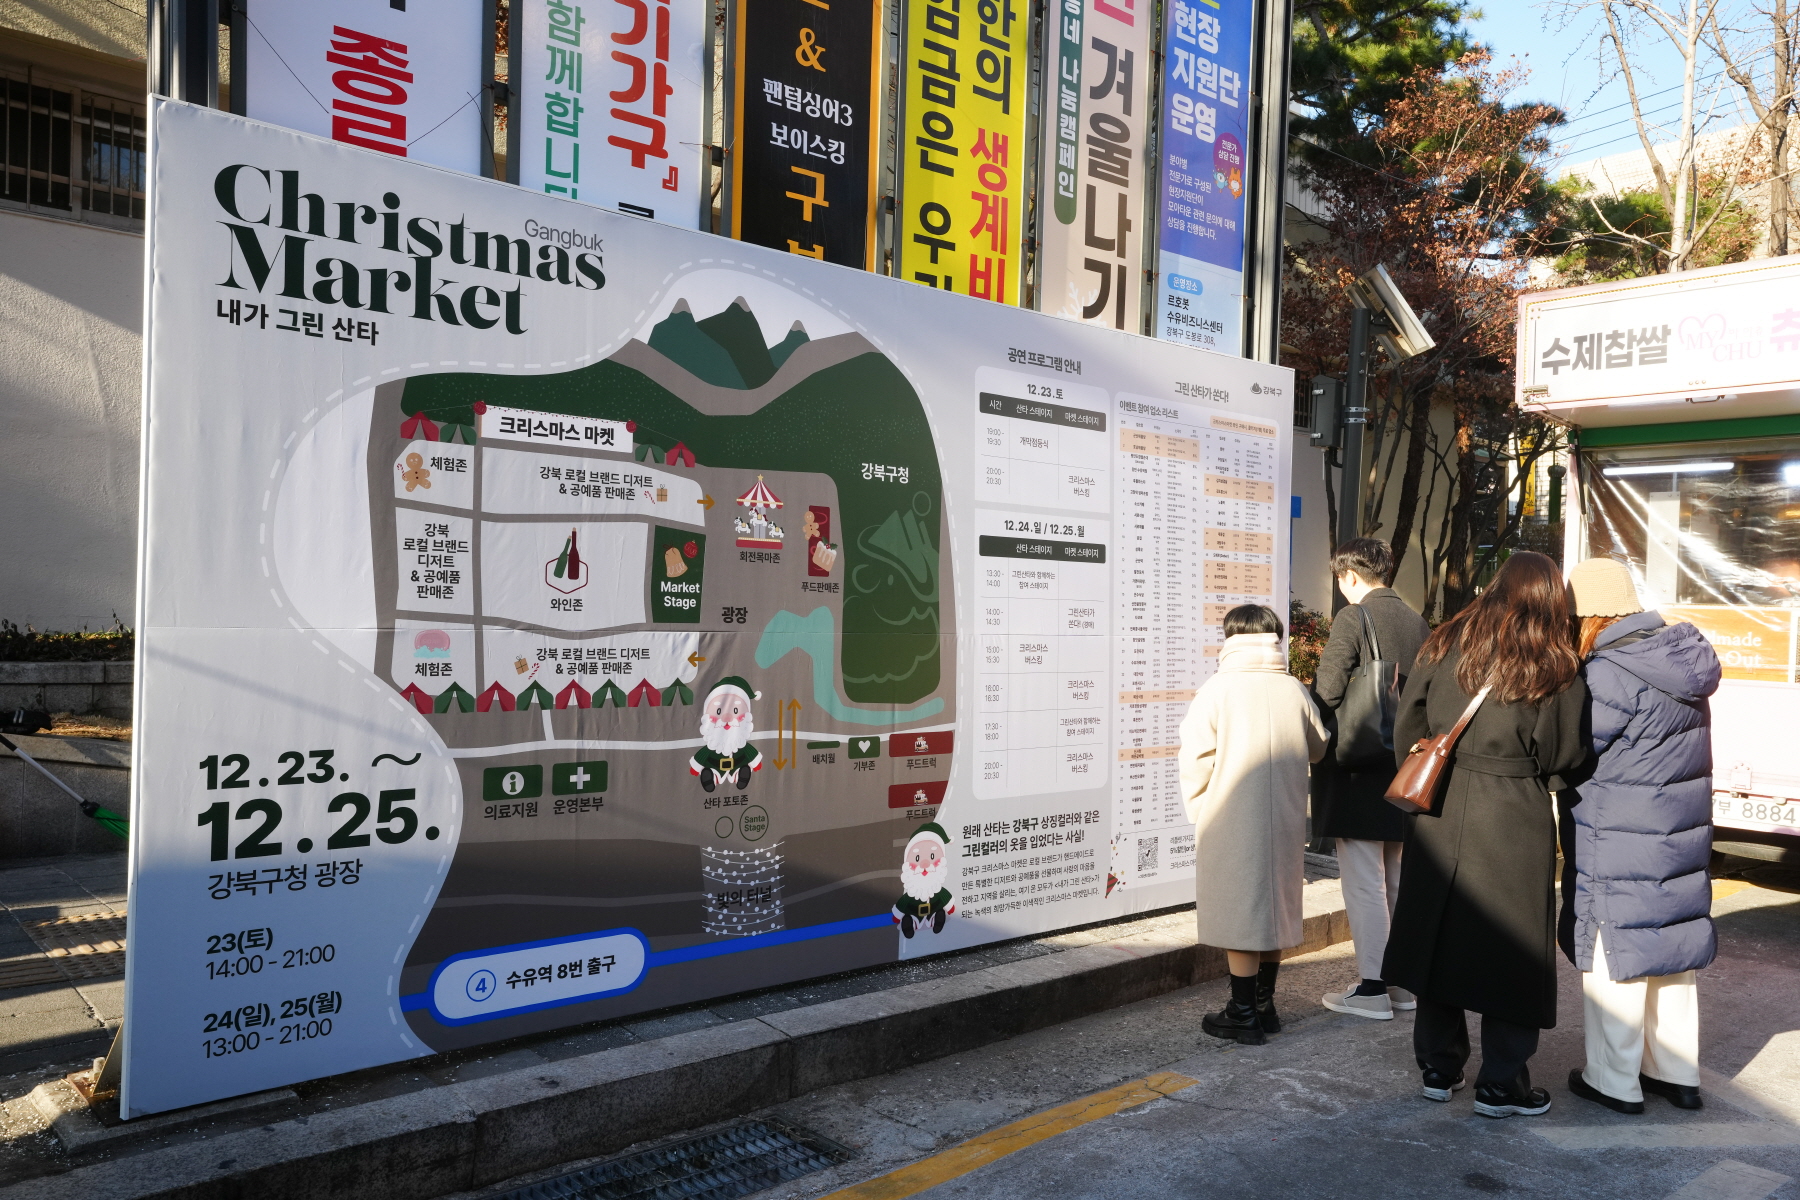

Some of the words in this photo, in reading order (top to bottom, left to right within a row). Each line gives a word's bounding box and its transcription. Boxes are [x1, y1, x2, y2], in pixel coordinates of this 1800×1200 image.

[1174, 0, 1221, 54] 현장
[795, 28, 826, 72] &
[1172, 47, 1241, 108] 지원단
[545, 0, 585, 199] 함께합니
[763, 78, 853, 127] 팬텀싱어3
[1171, 93, 1216, 143] 운영
[770, 122, 845, 165] 보이스킹
[1169, 154, 1188, 170] 분야별
[1083, 36, 1134, 330] 겨울나기
[1168, 170, 1193, 187] 전문가로
[1194, 179, 1212, 194] 구성된
[1168, 185, 1204, 206] 현장지원단이
[970, 128, 1009, 303] 생계비
[1167, 201, 1192, 218] 모아타운
[1224, 219, 1236, 231] 대해
[214, 164, 606, 290] Christmas
[523, 218, 604, 252] Gangbuk
[1167, 216, 1186, 232] 상담을
[1187, 222, 1217, 240] 진행합니다.
[215, 221, 527, 335] Market
[1173, 276, 1198, 292] 운영장소
[1167, 294, 1190, 311] 르호봇
[217, 300, 268, 330] 내가
[275, 308, 324, 338] 그린
[331, 316, 379, 346] 산타
[1166, 310, 1223, 334] 수유비즈니스센터
[1166, 327, 1184, 339] 강북구
[1185, 331, 1202, 342] 도봉로
[1541, 324, 1671, 376] 수제찹쌀
[1008, 347, 1026, 365] 공연
[1027, 352, 1063, 372] 프로그램
[1064, 359, 1082, 375] 안내
[1175, 382, 1190, 397] 그린
[1190, 384, 1212, 400] 산타가
[1213, 388, 1229, 403] 쏜다!
[1263, 386, 1283, 398] 강북구
[989, 399, 1002, 411] 시간
[1016, 404, 1028, 415] 산타
[1029, 407, 1053, 418] 스테이지
[1065, 412, 1077, 423] 마켓
[1078, 414, 1099, 426] 스테이지
[1119, 400, 1137, 412] 이벤트
[1137, 403, 1149, 415] 참여
[1150, 405, 1162, 417] 업소
[1162, 408, 1179, 419] 리스트
[499, 416, 581, 442] 크리스마스
[584, 424, 615, 446] 마켓
[1019, 436, 1049, 449] 개막점등식
[430, 457, 467, 473] 체험존
[861, 463, 909, 484] 강북구청
[539, 466, 564, 481] 강북
[565, 468, 590, 483] 로컬
[591, 470, 620, 486] 브랜드
[623, 473, 653, 488] 디저트
[1068, 475, 1096, 486] 크리스마스
[559, 484, 567, 494] &
[569, 483, 602, 499] 공예품
[604, 486, 635, 501] 판매존
[1073, 487, 1090, 498] 버스킹
[424, 523, 449, 538] 강북
[403, 538, 429, 553] 로컬
[433, 539, 469, 554] 브랜드
[1015, 544, 1028, 554] 산타
[1029, 545, 1052, 555] 스테이지
[1065, 547, 1077, 557] 마켓
[1077, 548, 1099, 559] 스테이지
[417, 554, 455, 569] 디저트
[739, 551, 781, 564] 회전목마존
[410, 570, 420, 582] &
[423, 570, 461, 584] 공예품
[416, 585, 454, 599] 판매존
[660, 581, 700, 594] Market
[801, 582, 840, 594] 푸드판매존
[550, 598, 584, 612] 와인존
[663, 596, 697, 610] Stage
[721, 607, 748, 624] 광장
[536, 648, 559, 661] 강북
[561, 647, 584, 661] 로컬
[587, 647, 617, 660] 브랜드
[620, 647, 651, 660] 디저트
[1019, 644, 1048, 653] 크리스마스
[414, 662, 453, 677] 체험존
[555, 663, 564, 674] &
[566, 662, 599, 675] 공예품
[601, 661, 633, 675] 판매존
[1024, 656, 1043, 665] 버스킹
[1067, 680, 1094, 689] 크리스마스
[1073, 691, 1089, 700] 버스킹
[853, 760, 876, 772] 기부존
[906, 757, 937, 770] 푸드트럭
[1066, 753, 1094, 762] 크리스마스
[1072, 764, 1088, 773] 버스킹
[484, 801, 538, 820] 의료지원
[553, 797, 604, 815] 운영본부
[703, 796, 721, 810] 산타
[723, 795, 749, 807] 포토존
[744, 815, 766, 824] Santa
[905, 807, 936, 821] 푸드트럭
[1742, 802, 1796, 824] 8884
[198, 788, 440, 861] 12.25.
[744, 823, 766, 833] Stage
[962, 824, 981, 839] 원래
[983, 821, 1010, 837] 산타는
[1012, 817, 1039, 833] 강북구
[1041, 812, 1082, 830] 상징컬러와
[1084, 810, 1100, 825] 같은
[962, 839, 1008, 858] 그린컬러의
[1010, 836, 1028, 852] 옷을
[1030, 832, 1063, 849] 입었다는
[1065, 829, 1085, 845] 사실!
[962, 866, 979, 877] 강북구
[981, 862, 1010, 873] 크리스마스
[208, 864, 308, 900] 강북구청
[315, 858, 363, 887] 광장
[718, 890, 743, 910] 빛의
[747, 885, 772, 904] 터널
[206, 928, 274, 954] 23(토)
[206, 954, 264, 980] 14:00
[282, 944, 335, 969] 21:00
[506, 965, 552, 989] 수유역
[557, 960, 583, 979] 8번
[587, 954, 616, 975] 출구
[475, 977, 487, 993] 4
[203, 1003, 276, 1033] 24(일),
[280, 991, 343, 1020] 25(월)
[202, 1031, 260, 1059] 13:00
[279, 1018, 332, 1044] 21:00
